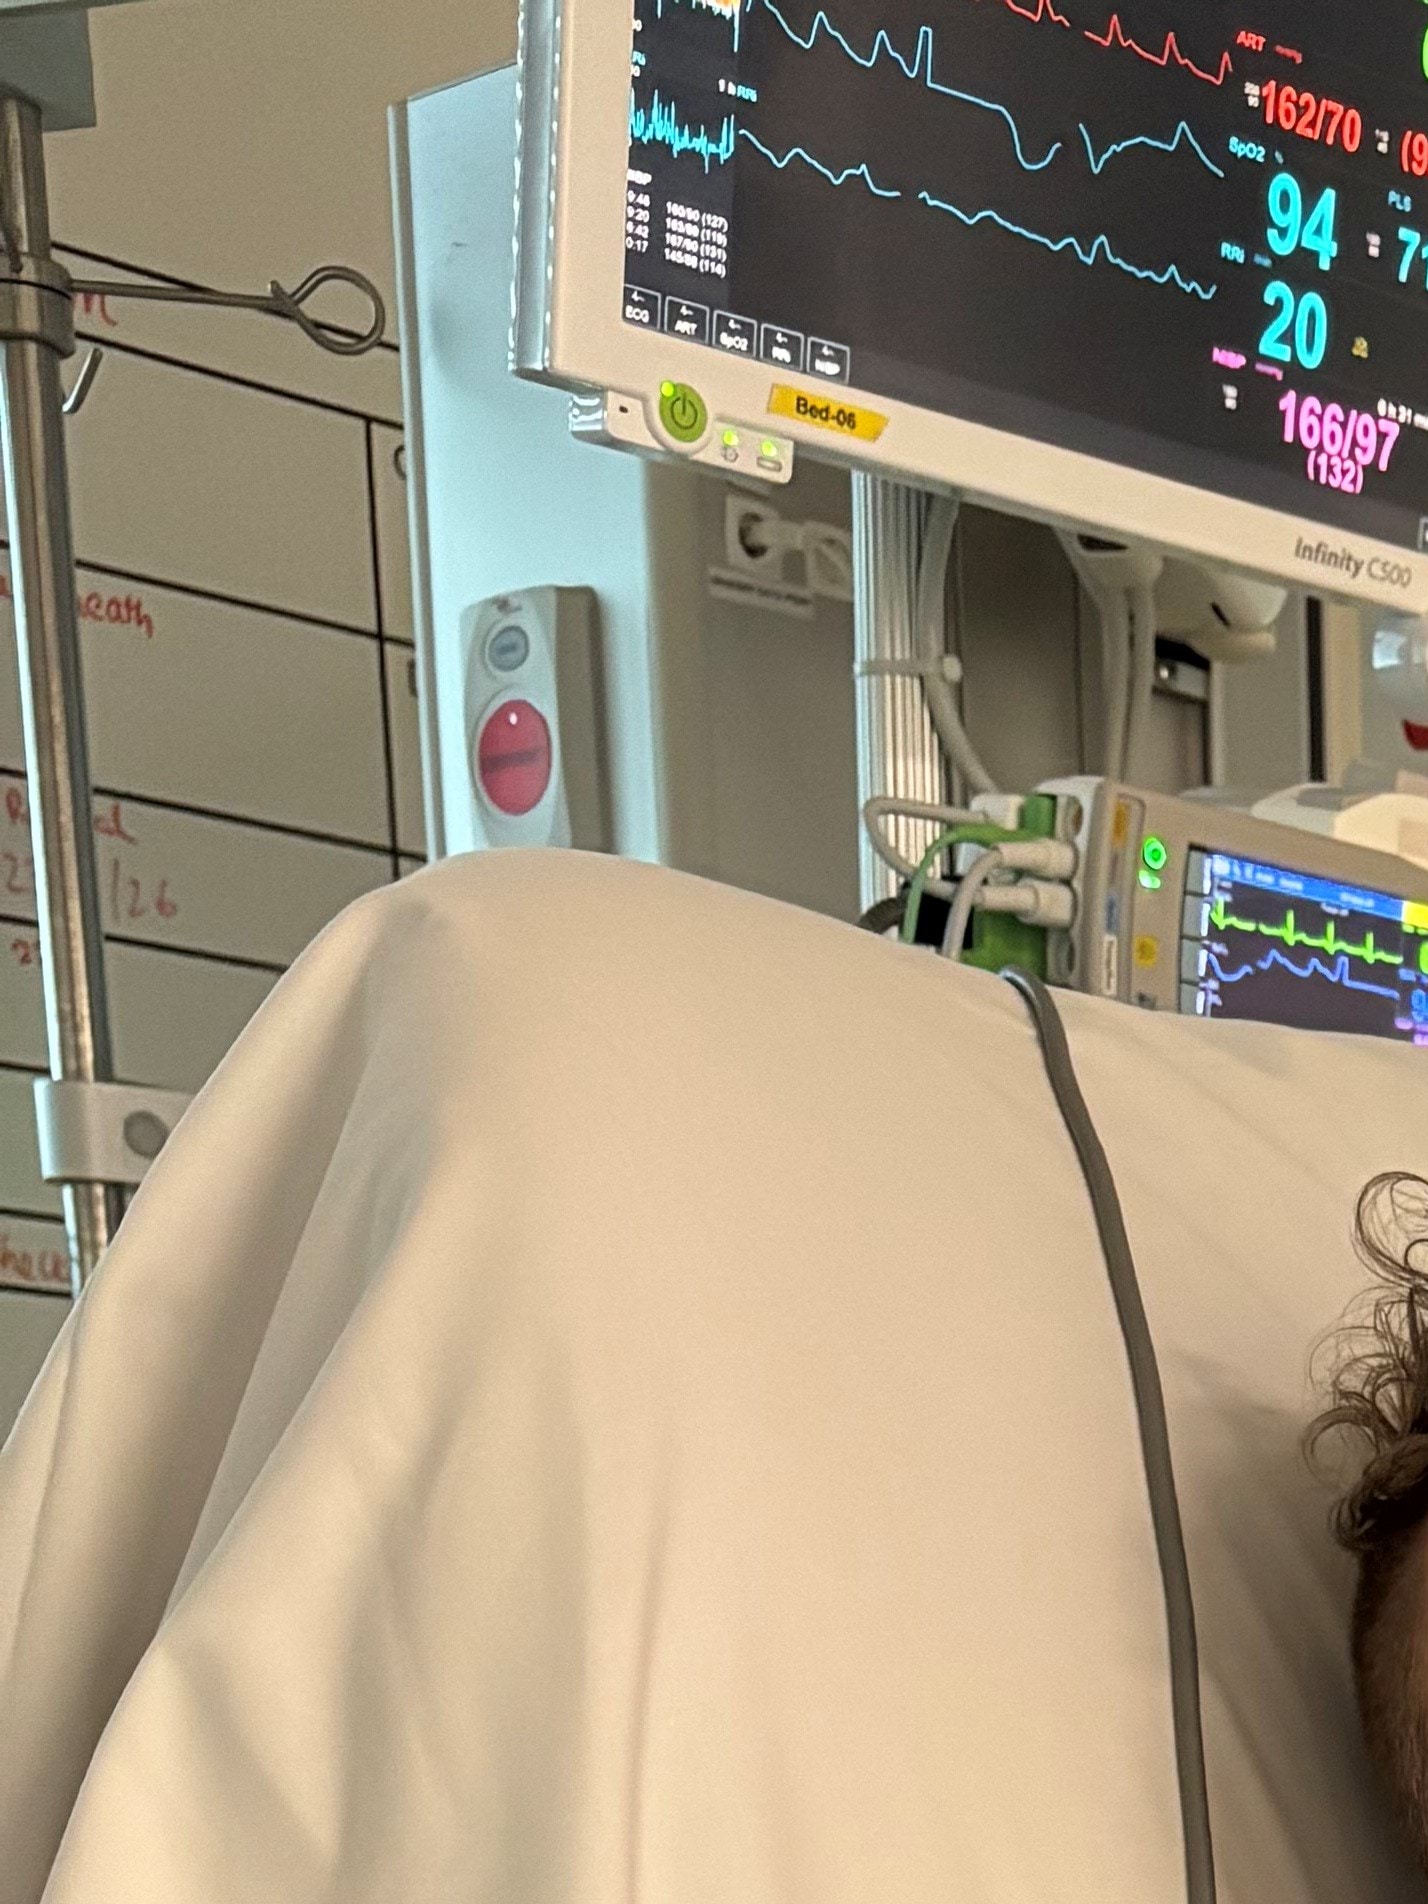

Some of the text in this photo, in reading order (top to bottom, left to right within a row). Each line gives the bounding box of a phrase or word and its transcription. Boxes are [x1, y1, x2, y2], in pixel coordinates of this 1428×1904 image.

[1237, 30, 1267, 51] ART
[1262, 79, 1362, 153] 162/70
[1228, 136, 1266, 163] SpO2
[1388, 190, 1412, 212] PLS
[1267, 172, 1338, 271] 94
[1220, 241, 1245, 264] RRi
[625, 305, 650, 323] ECG
[674, 320, 698, 336] ART
[1258, 280, 1328, 369] 20
[795, 395, 857, 430] Bed-06
[1278, 388, 1400, 472] 166/97
[1306, 450, 1364, 495] (132)
[1294, 536, 1413, 588] Infinity C500
